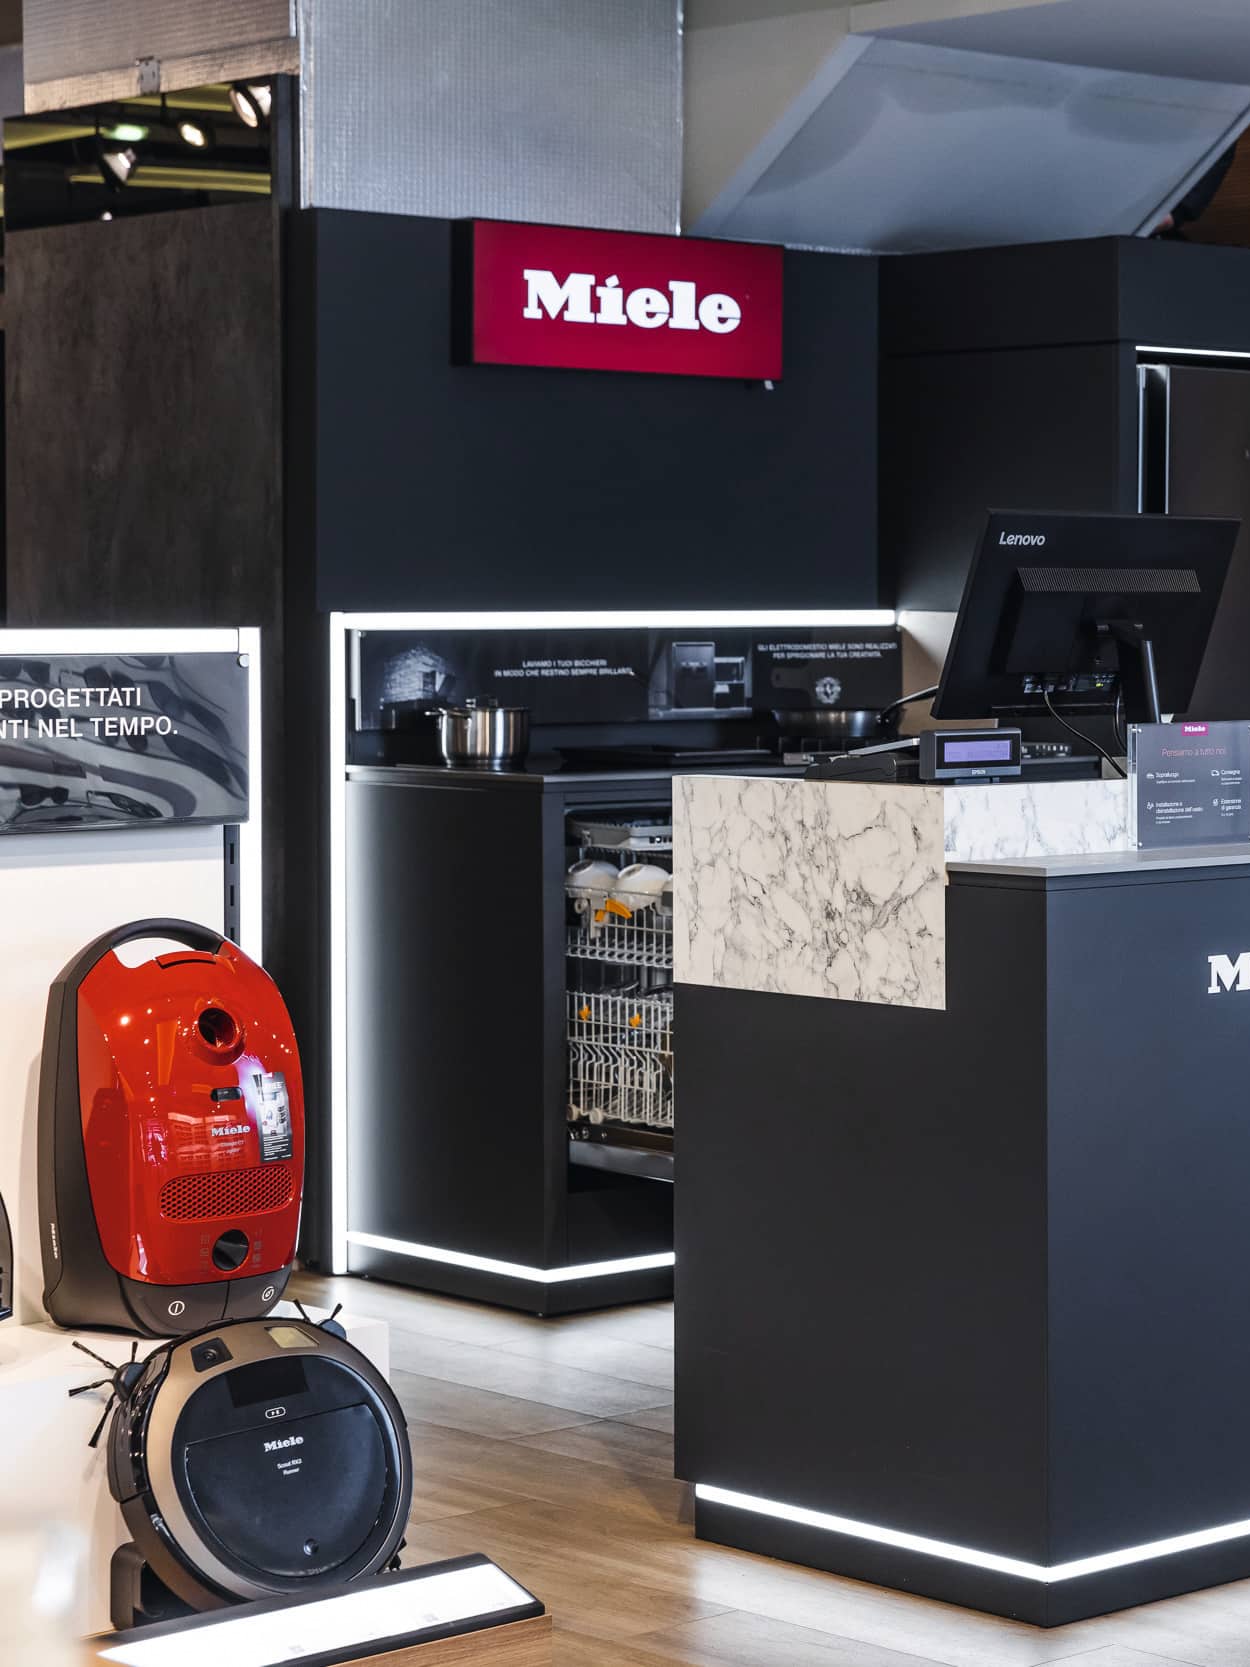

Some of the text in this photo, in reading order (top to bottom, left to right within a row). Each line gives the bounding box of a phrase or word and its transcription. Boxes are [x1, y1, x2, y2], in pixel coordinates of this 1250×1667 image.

[523, 268, 742, 334] Miele
[999, 531, 1046, 546] Lenovo
[0, 687, 141, 709] PROGETTATI
[38, 718, 83, 738] NEL
[90, 716, 178, 737] TEMPO.
[211, 1124, 251, 1137] Miele
[263, 1436, 304, 1453] Miele
